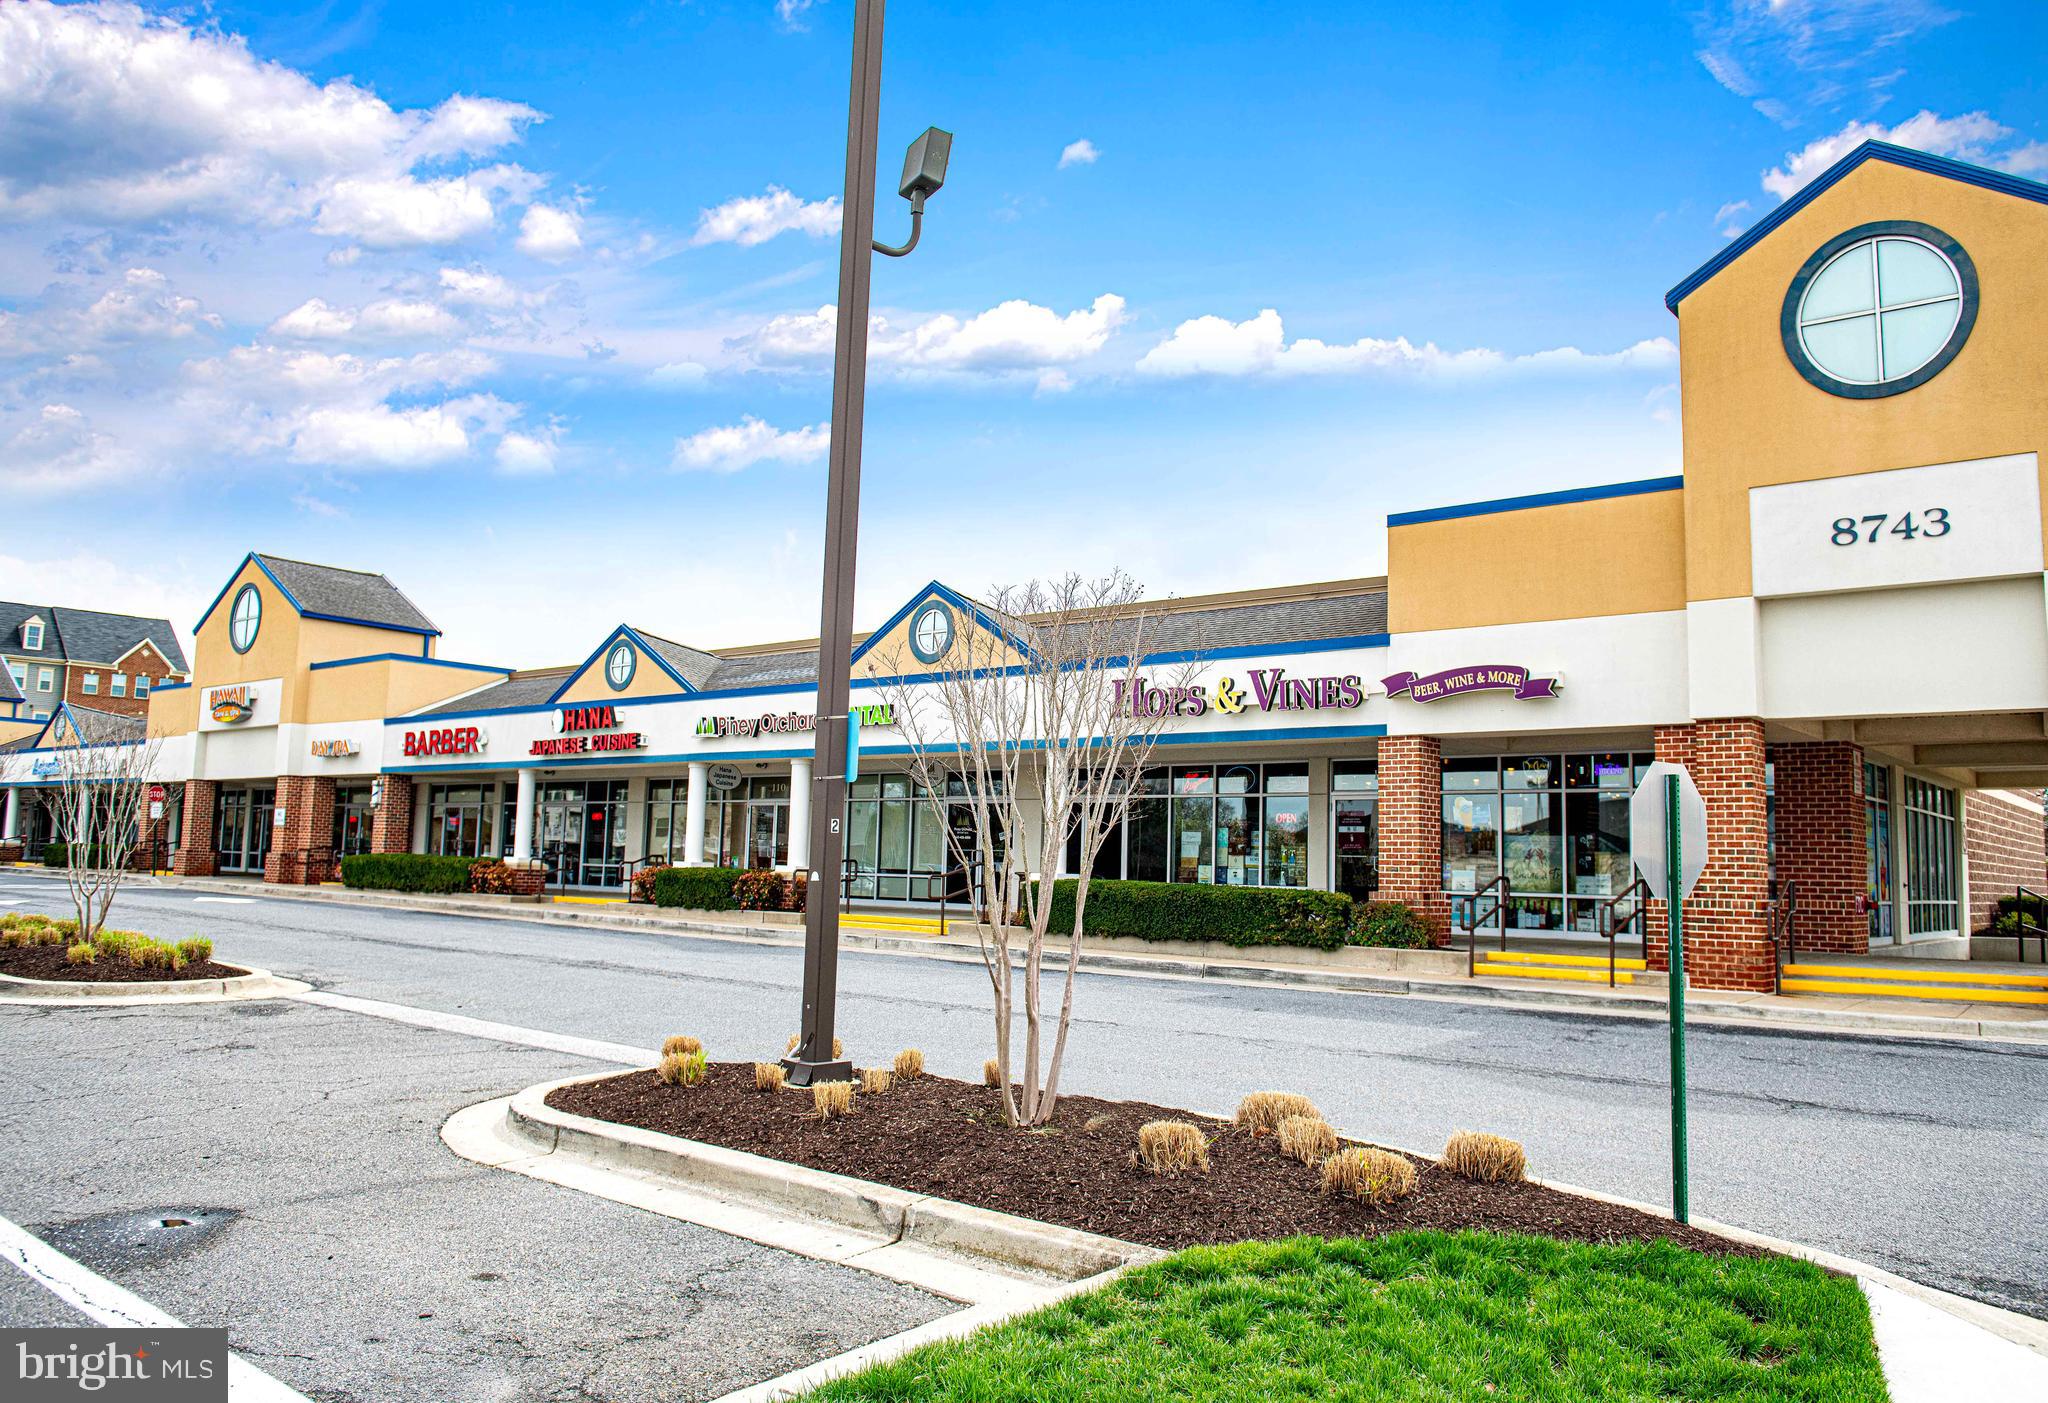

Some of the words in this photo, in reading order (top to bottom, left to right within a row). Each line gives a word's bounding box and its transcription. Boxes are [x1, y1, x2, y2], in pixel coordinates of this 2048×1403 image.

[1831, 507, 1951, 546] 8743
[1111, 675, 1204, 719] HOPS
[1213, 676, 1246, 714] &
[1246, 667, 1364, 712] VINES
[1414, 681, 1444, 697] BEER,
[1444, 672, 1474, 690] WINE
[1476, 671, 1486, 684] &
[1487, 670, 1521, 687] MORE
[209, 686, 246, 710] HAWAII
[563, 705, 614, 732] HANA
[718, 714, 757, 737] Piney
[311, 740, 329, 757] DAY
[331, 739, 349, 757] SPA
[403, 725, 480, 757] BARBER
[529, 736, 584, 756] JAPANESE
[591, 732, 638, 752] CUISINE
[713, 771, 737, 781] Japanese
[716, 779, 734, 787] Cuisine
[149, 790, 164, 798] STOP
[771, 783, 786, 793] 110
[831, 819, 839, 833] 2
[1275, 812, 1297, 823] OPEN
